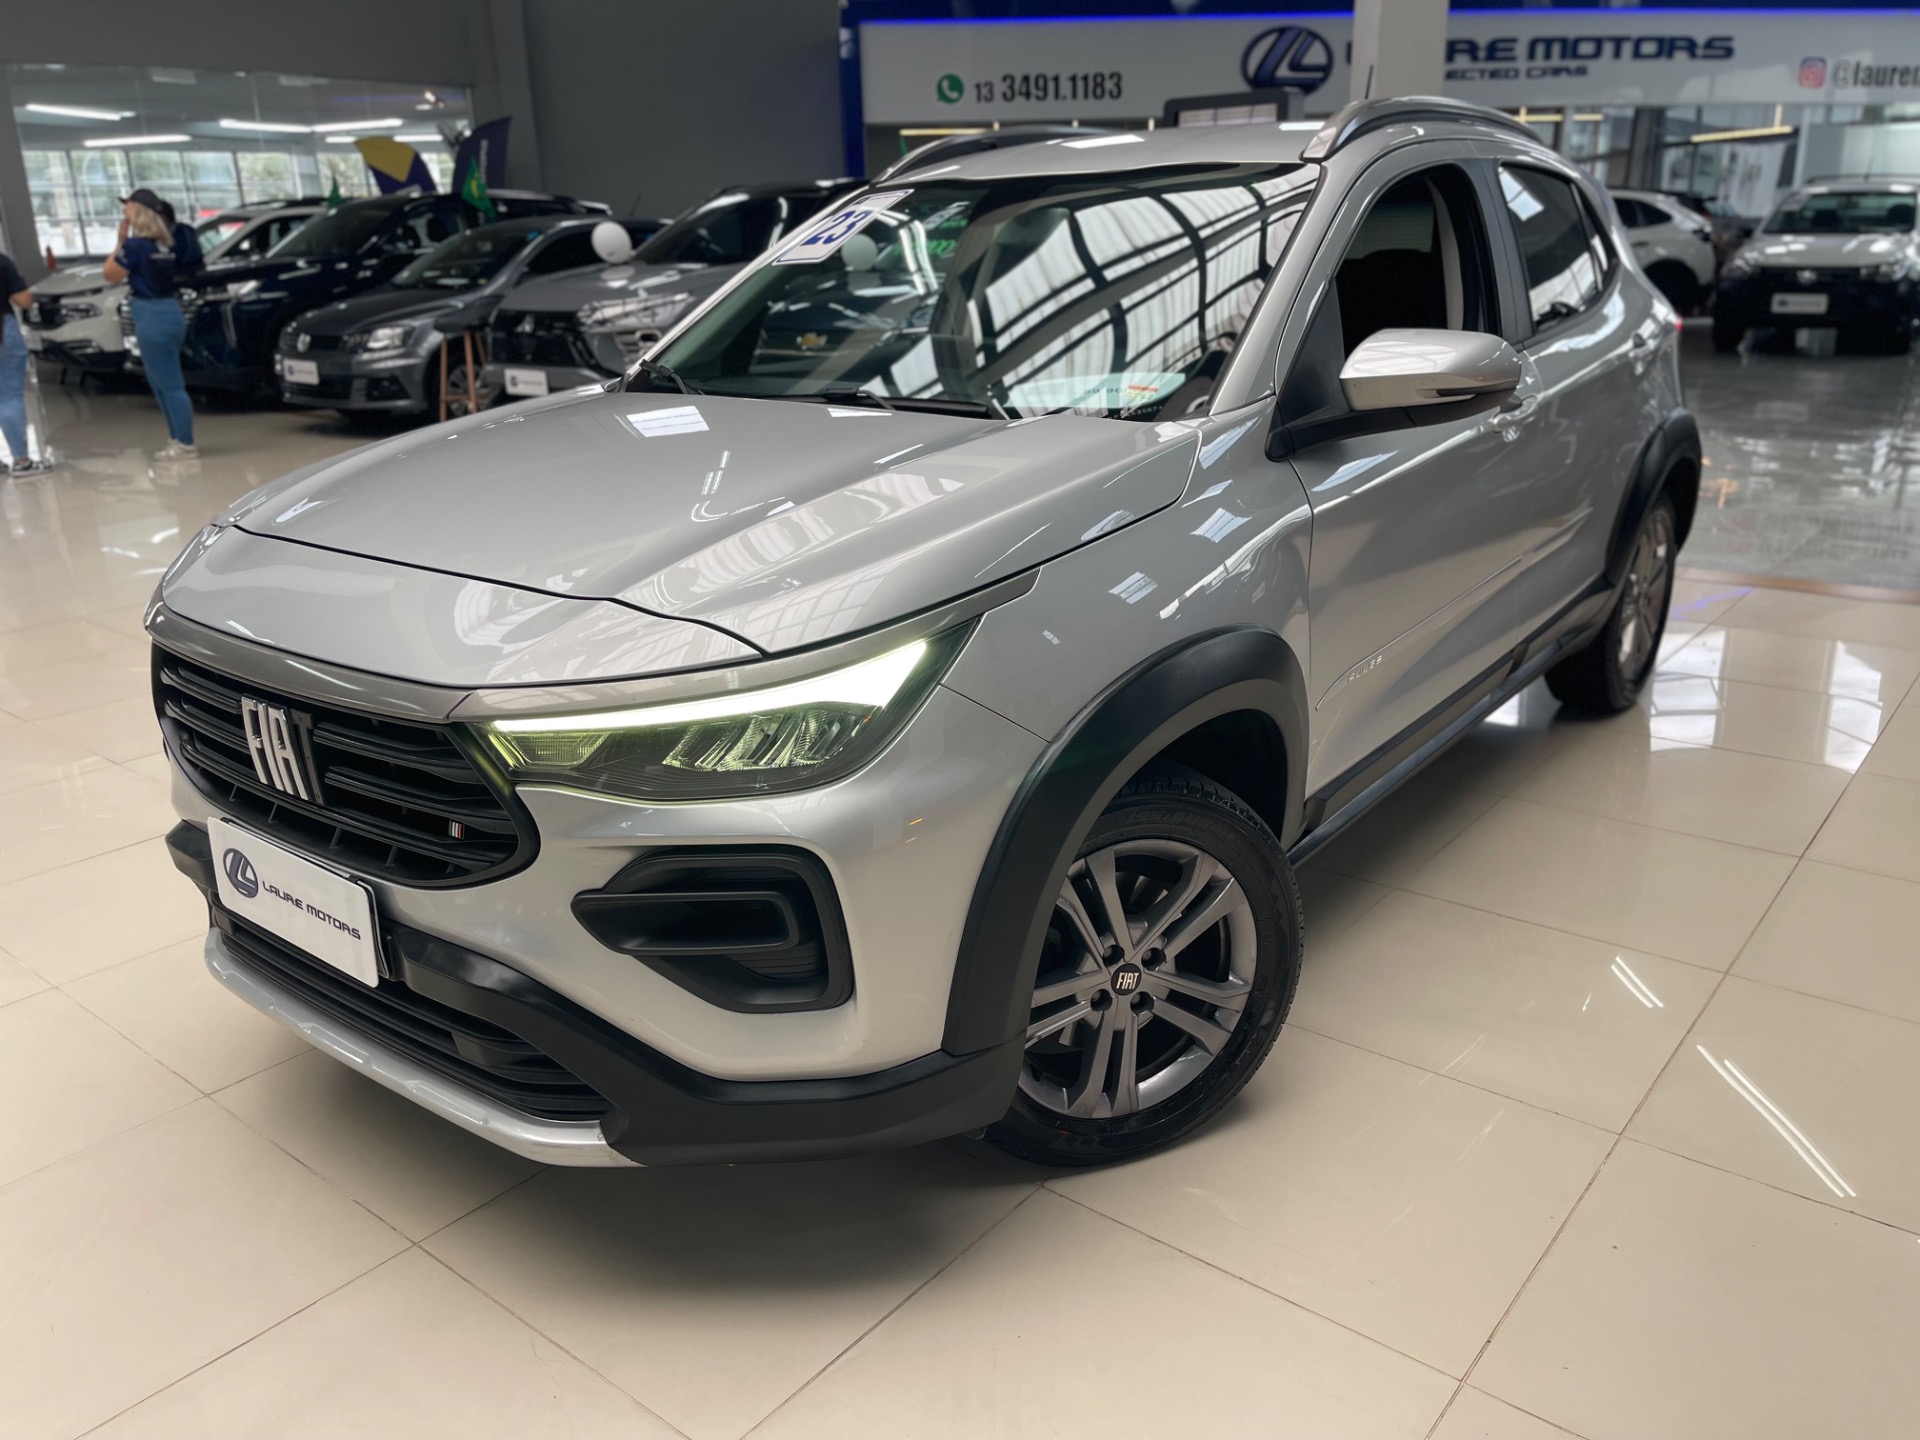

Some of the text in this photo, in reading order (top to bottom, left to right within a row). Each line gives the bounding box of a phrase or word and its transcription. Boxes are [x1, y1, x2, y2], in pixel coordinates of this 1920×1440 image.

[1527, 35, 1734, 61] MOTORS
[974, 72, 1122, 102] 13 3491.1183
[1444, 64, 1588, 81] ECTED CARS
[800, 210, 874, 246] 23
[241, 693, 325, 806] FIAT
[262, 880, 361, 940] LAURE MOTORS
[1116, 972, 1140, 990] FIAT
